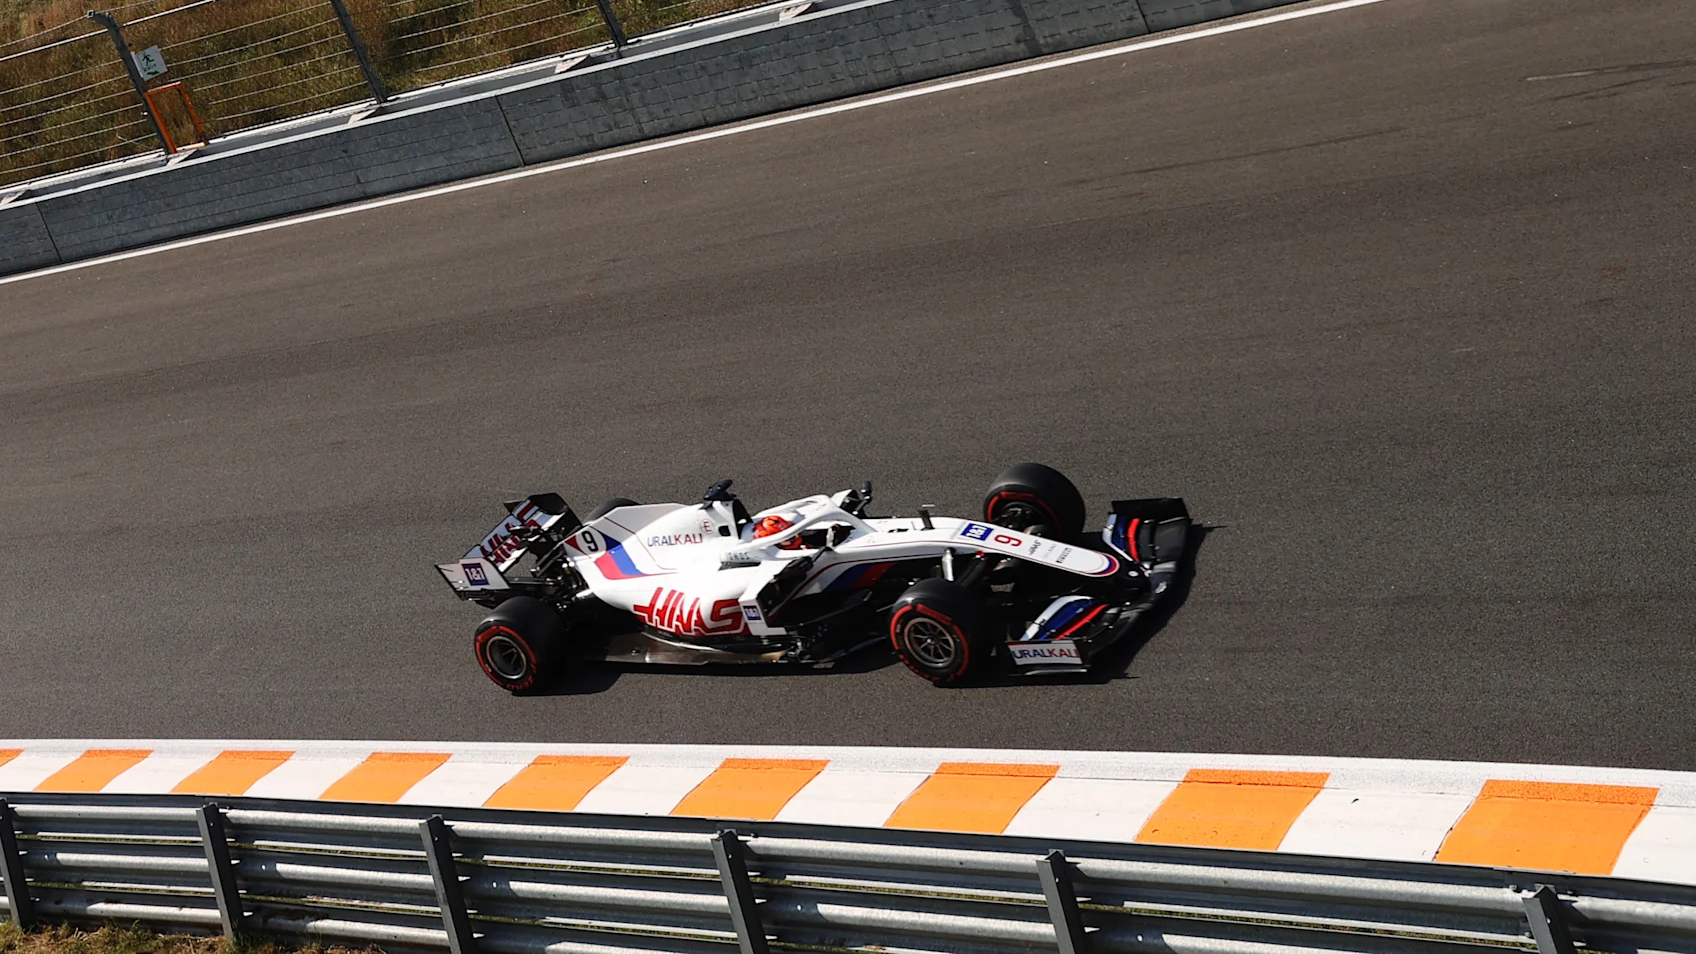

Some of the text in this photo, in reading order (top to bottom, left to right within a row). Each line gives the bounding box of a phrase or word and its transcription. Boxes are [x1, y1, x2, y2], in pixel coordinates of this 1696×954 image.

[966, 525, 988, 539] 1&1
[582, 531, 599, 552] 9
[647, 533, 703, 547] URALKALI
[994, 534, 1022, 547] 9
[465, 567, 487, 581] 1&1
[633, 587, 746, 636] HAAS
[1012, 648, 1081, 659] URALKALI
